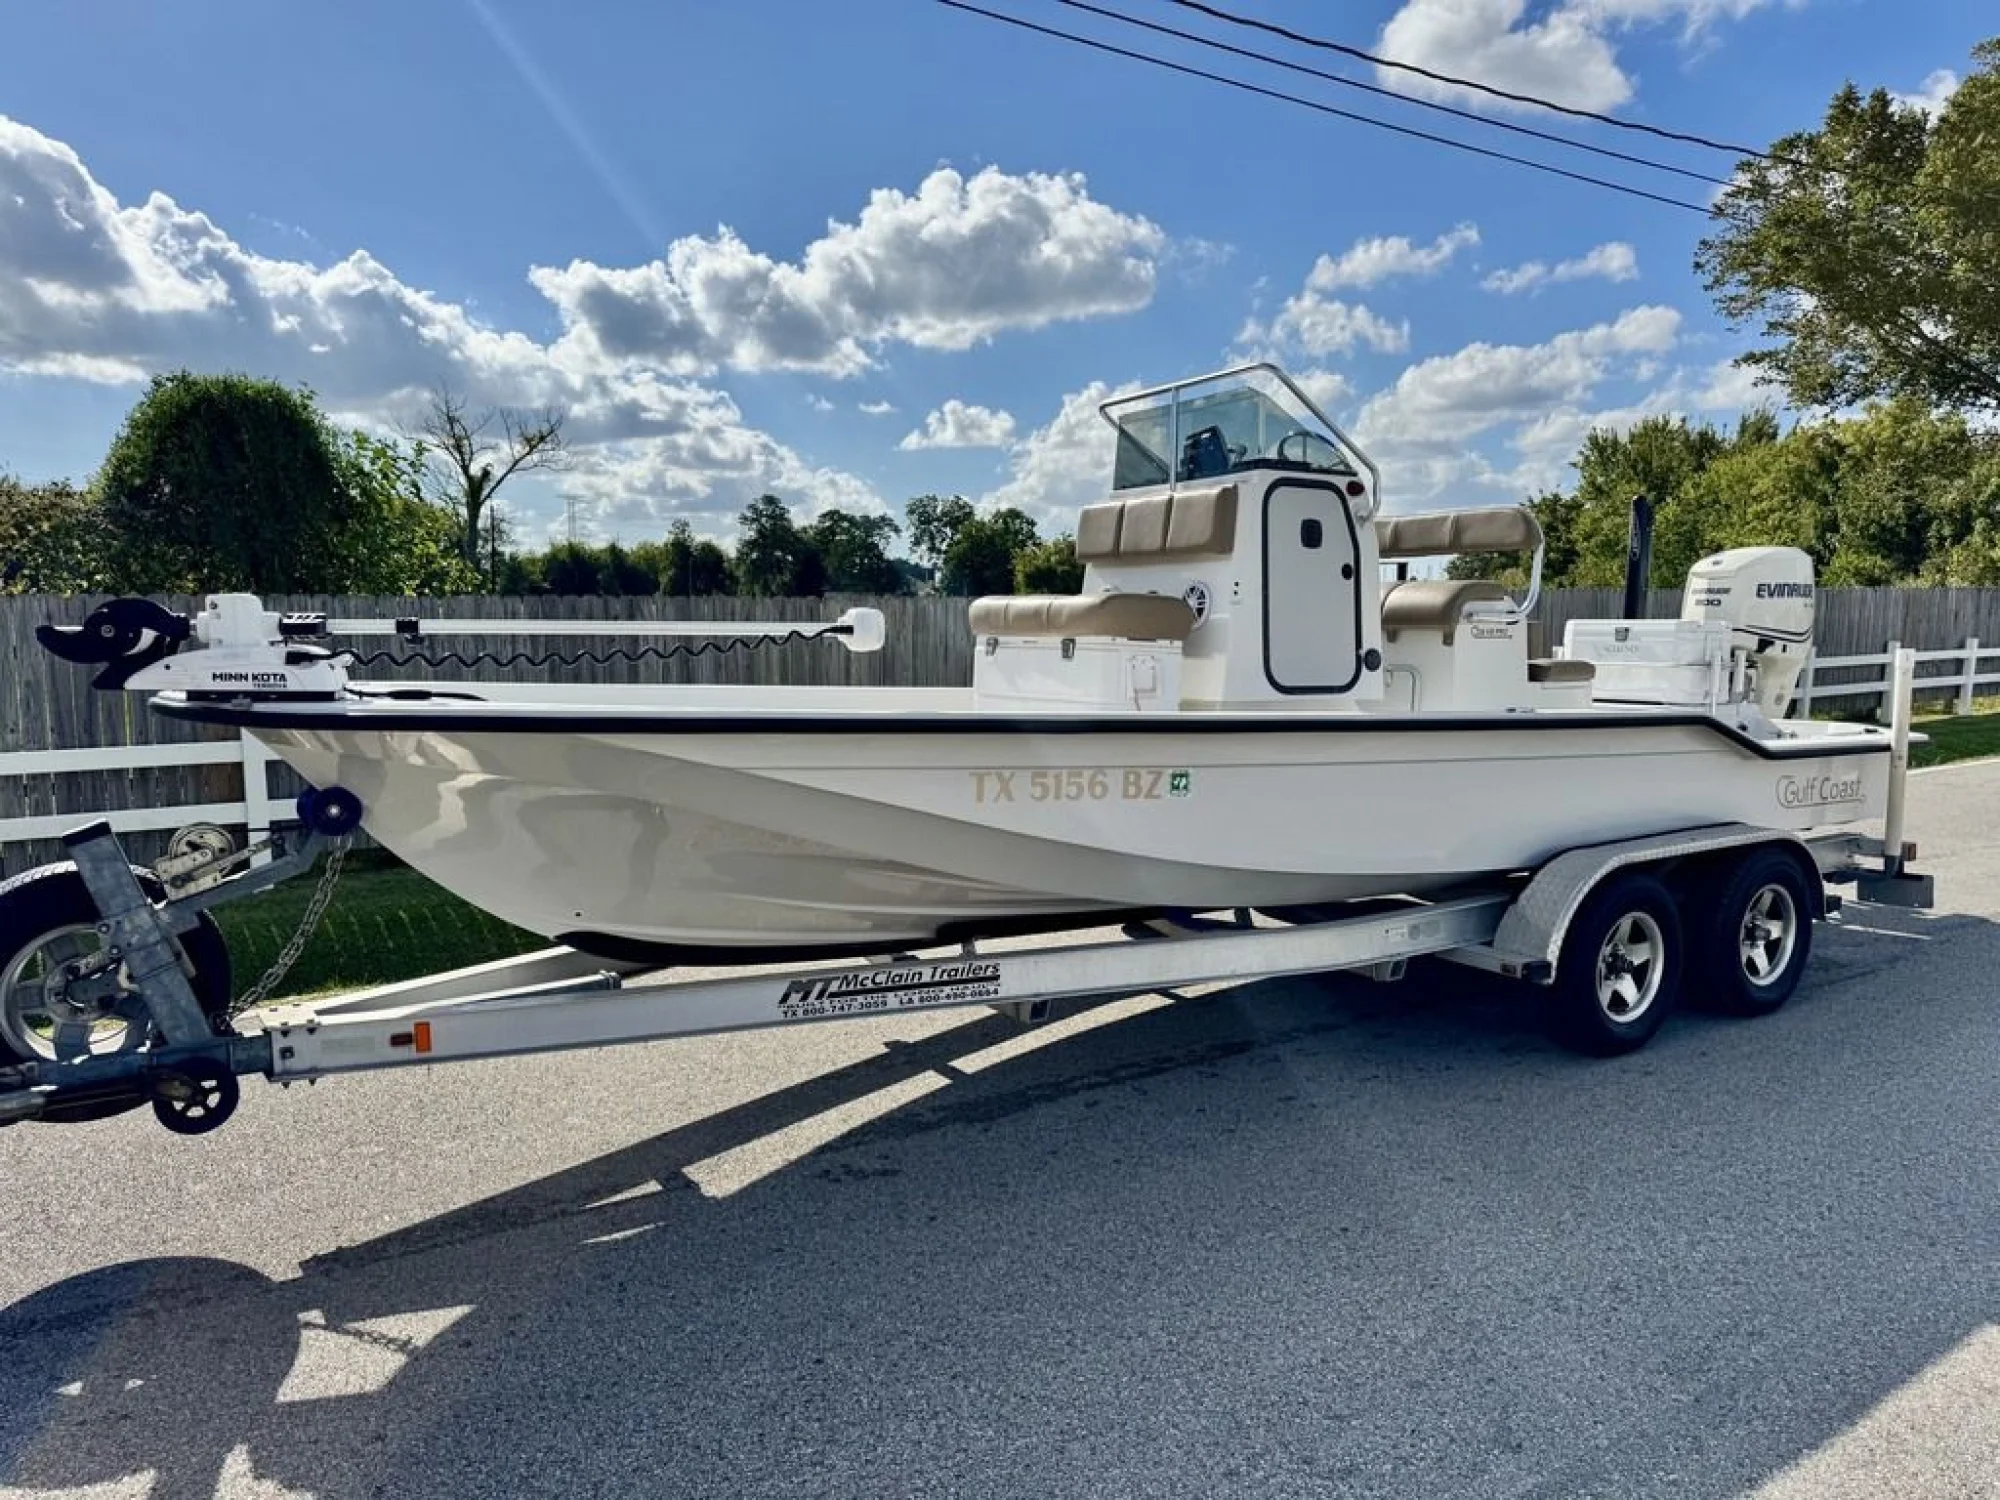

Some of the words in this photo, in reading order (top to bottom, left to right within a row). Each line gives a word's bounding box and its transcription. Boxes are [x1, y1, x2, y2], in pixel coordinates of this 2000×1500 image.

[212, 672, 249, 682] MINN
[252, 672, 288, 682] KOTA
[969, 770, 1016, 803] TX
[1030, 769, 1109, 801] 5156
[1122, 770, 1164, 800] BZ
[1784, 776, 1817, 803] Gulf
[1820, 776, 1862, 800] Coast
[838, 968, 923, 990] McClain
[929, 962, 1000, 981] Trailers
[778, 976, 841, 1005] MT
[782, 1009, 798, 1019] TX
